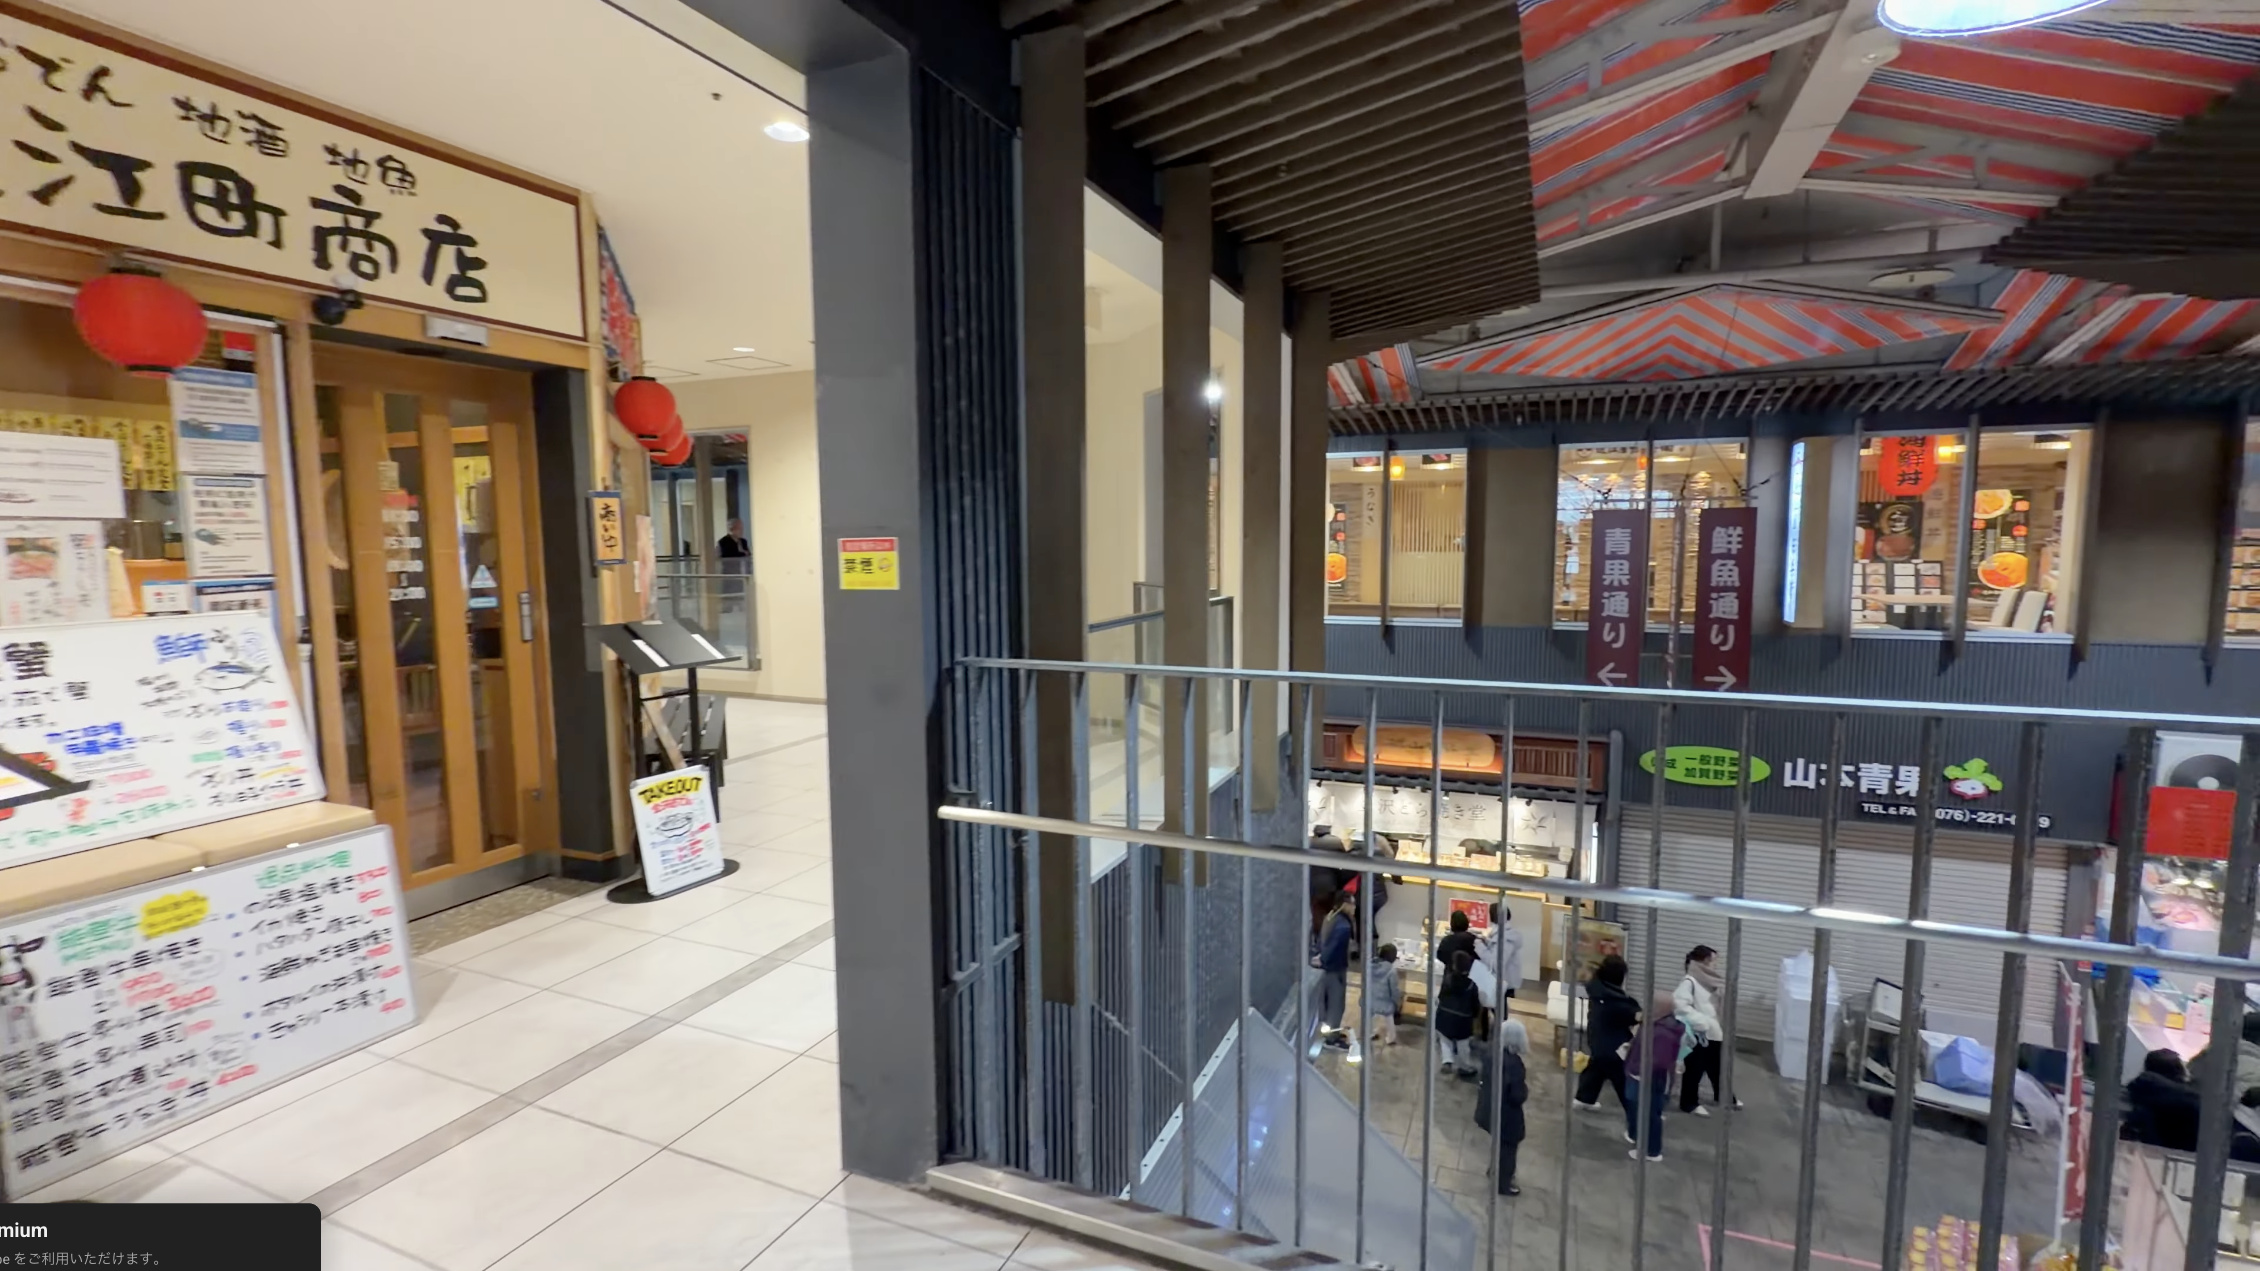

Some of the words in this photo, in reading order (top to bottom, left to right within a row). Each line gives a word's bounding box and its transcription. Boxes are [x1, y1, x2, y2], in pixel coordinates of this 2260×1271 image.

[0, 104, 489, 304] 江町商店
[172, 96, 290, 159] 地酒
[322, 142, 418, 197] 地魚
[1601, 527, 1632, 649] 青果通り
[1708, 526, 1744, 651] 鮮魚通り
[637, 776, 703, 804] TAKEOUT
